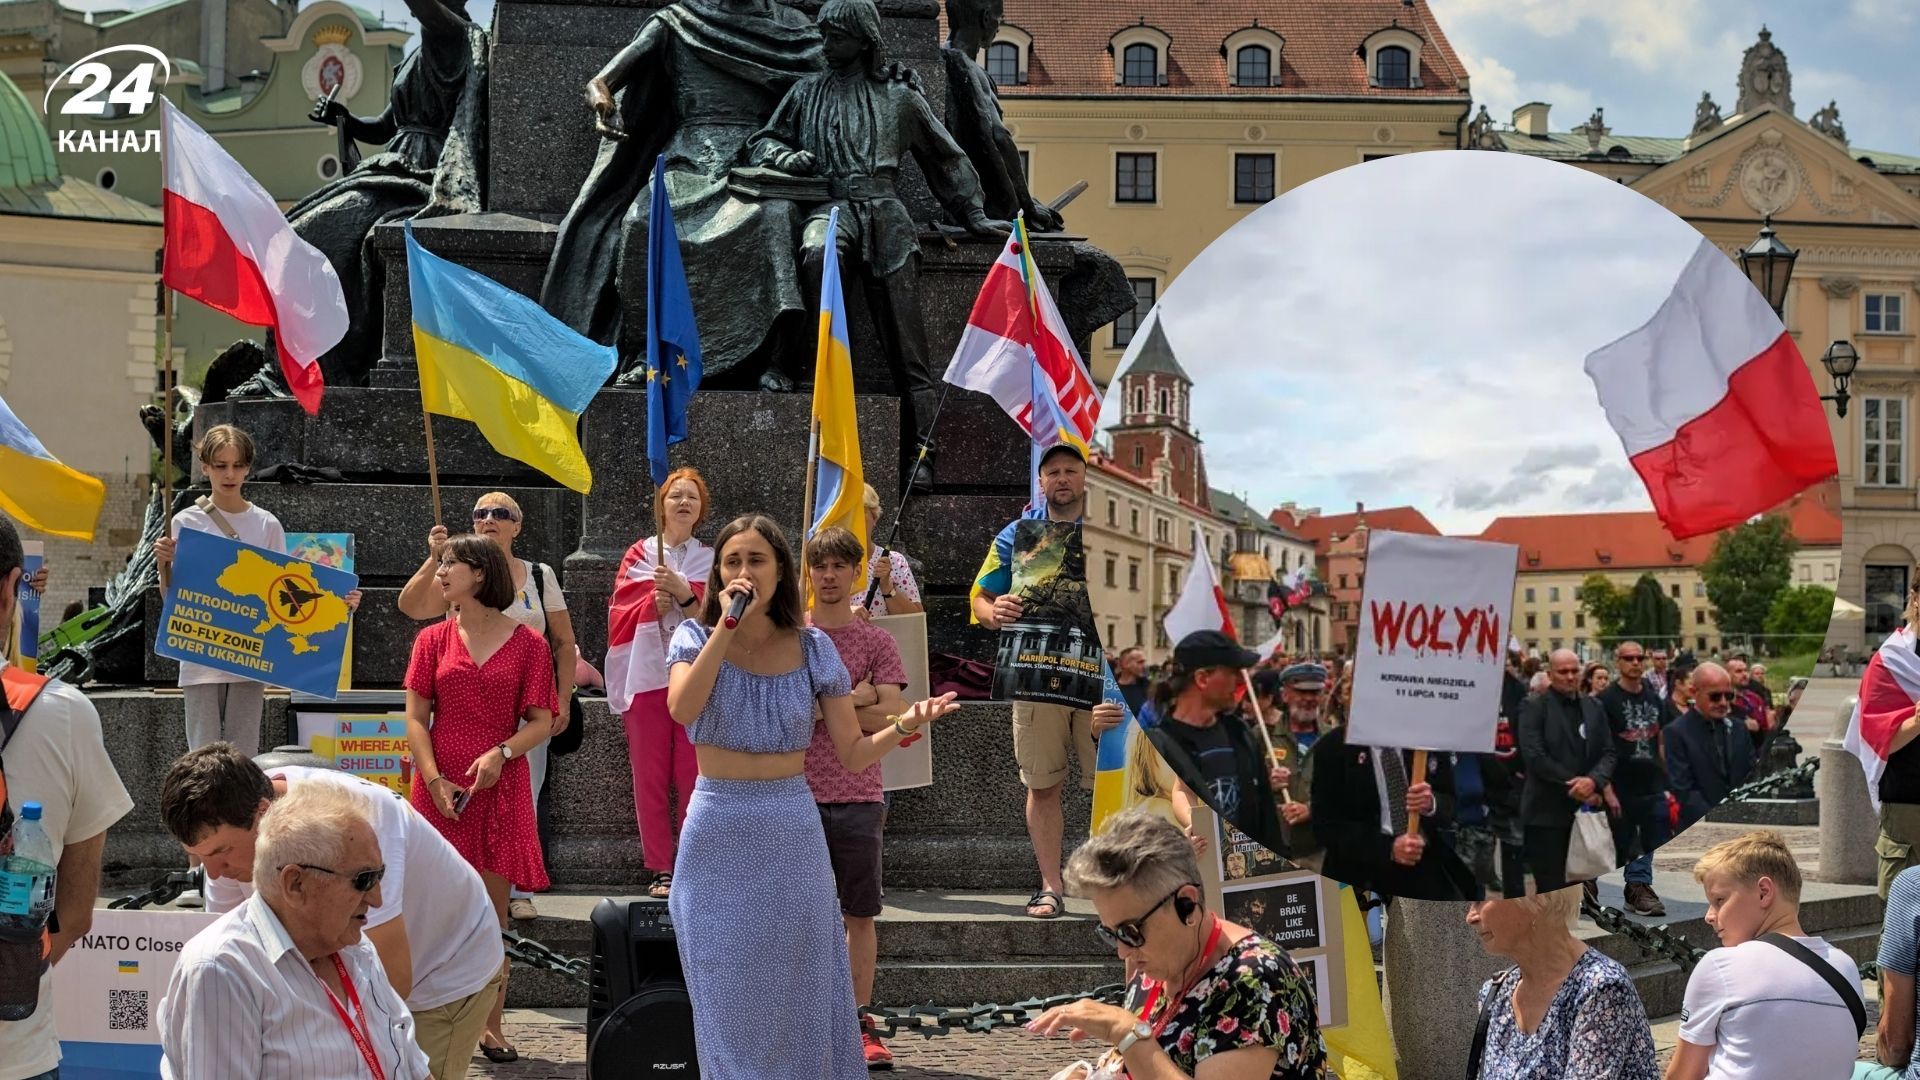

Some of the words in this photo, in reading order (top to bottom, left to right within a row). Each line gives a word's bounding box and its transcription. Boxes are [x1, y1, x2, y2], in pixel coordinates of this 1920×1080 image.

[177, 588, 259, 619] INTRODUCE
[174, 603, 212, 623] NATO
[170, 620, 221, 641] NO-FLY
[222, 633, 261, 653] ZONE
[1371, 600, 1499, 661] WOŁYŃ
[167, 636, 204, 655] OVER
[207, 646, 274, 673] UKRAINE!
[1019, 654, 1058, 665] MARIUPOL
[1060, 657, 1100, 673] FORTRESS
[1056, 665, 1079, 674] UKRAINE
[1079, 669, 1091, 678] WILL
[1427, 676, 1476, 688] NIEDZIELA
[1396, 688, 1406, 696] 11
[1408, 689, 1435, 698] LIPCA
[341, 740, 391, 751] WHERE
[340, 758, 394, 770] SHIELD
[1286, 894, 1298, 903] BE
[1280, 905, 1307, 916] BRAVE
[1285, 917, 1303, 928] LIKE
[1274, 928, 1315, 941] AZOVSTAL
[82, 935, 130, 950] NATO
[135, 937, 184, 953] Close
